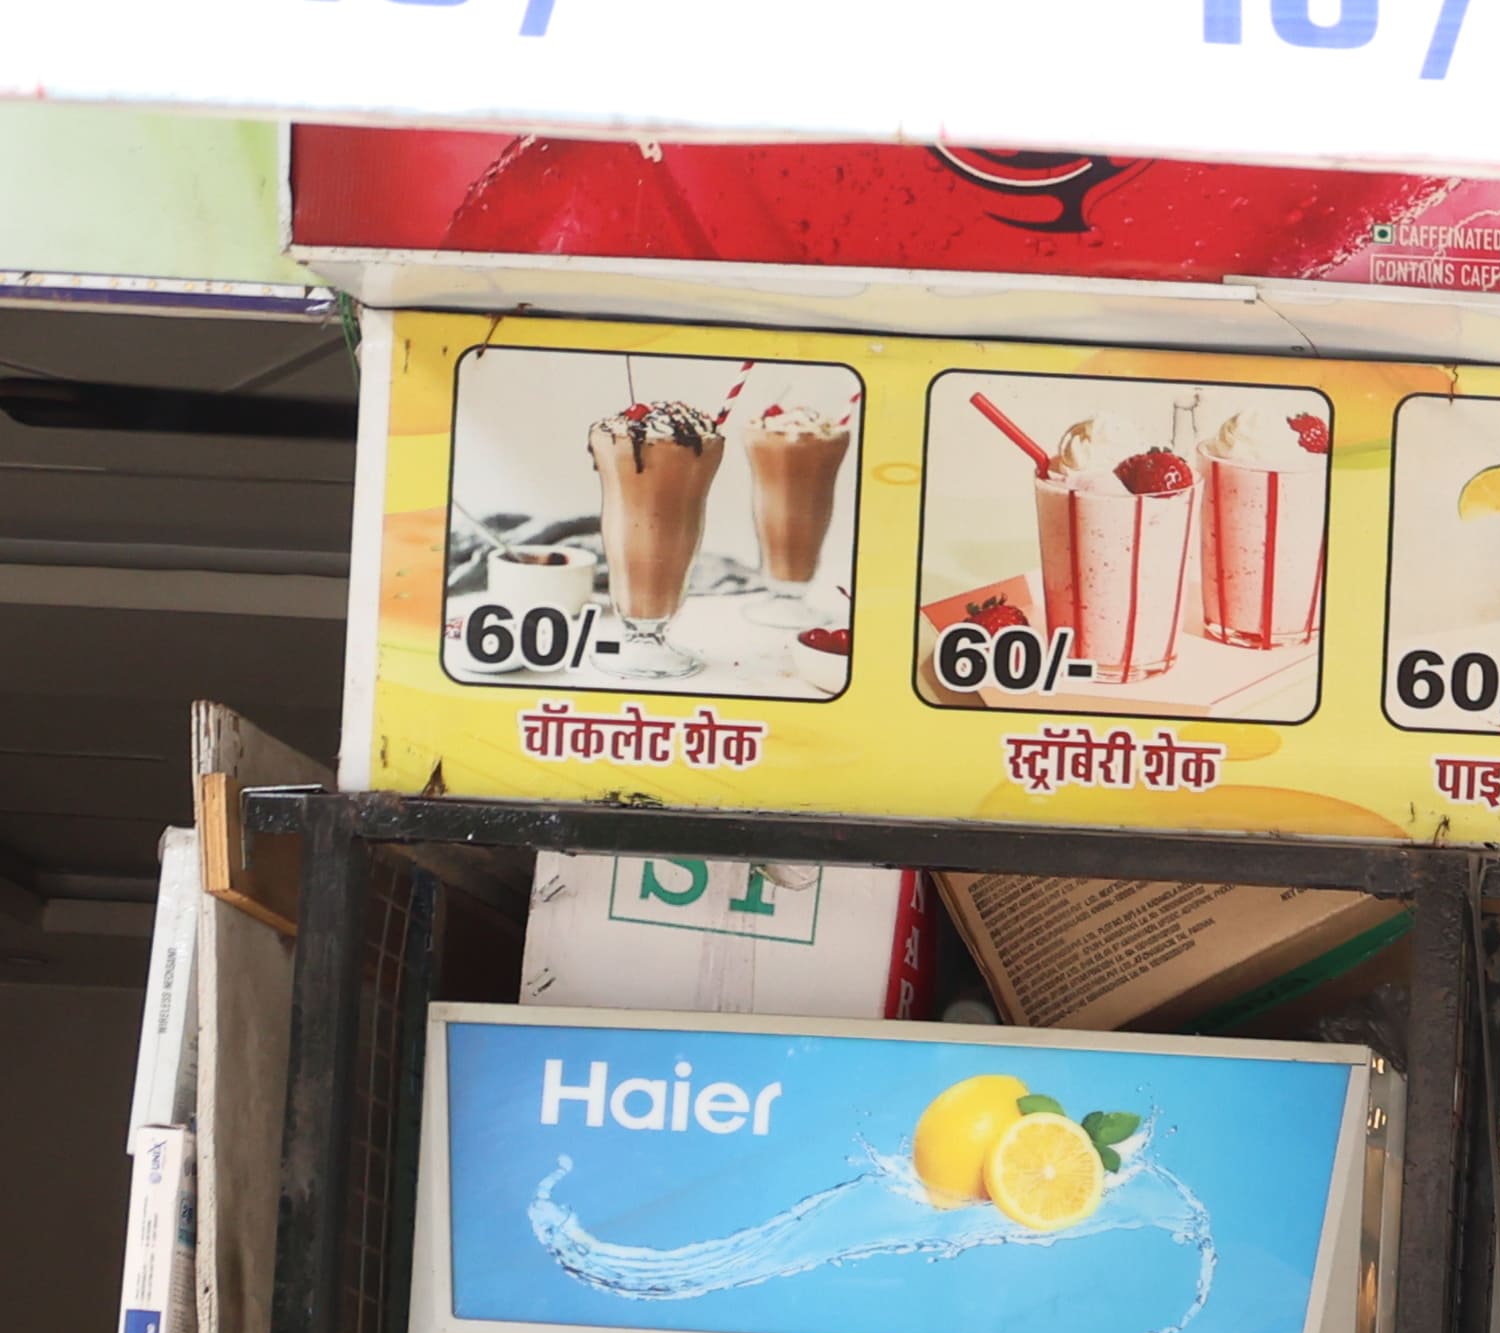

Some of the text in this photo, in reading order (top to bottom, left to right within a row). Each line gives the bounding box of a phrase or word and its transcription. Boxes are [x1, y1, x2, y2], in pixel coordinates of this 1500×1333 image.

[1374, 260, 1455, 286] CONTAINS
[464, 604, 620, 669] 60/-
[938, 626, 1094, 692] 60/-
[522, 704, 763, 767] चॉकलेट शेक
[1006, 727, 1222, 793] स्ट्रॉबेरी शेक
[540, 1058, 784, 1137] Haier
